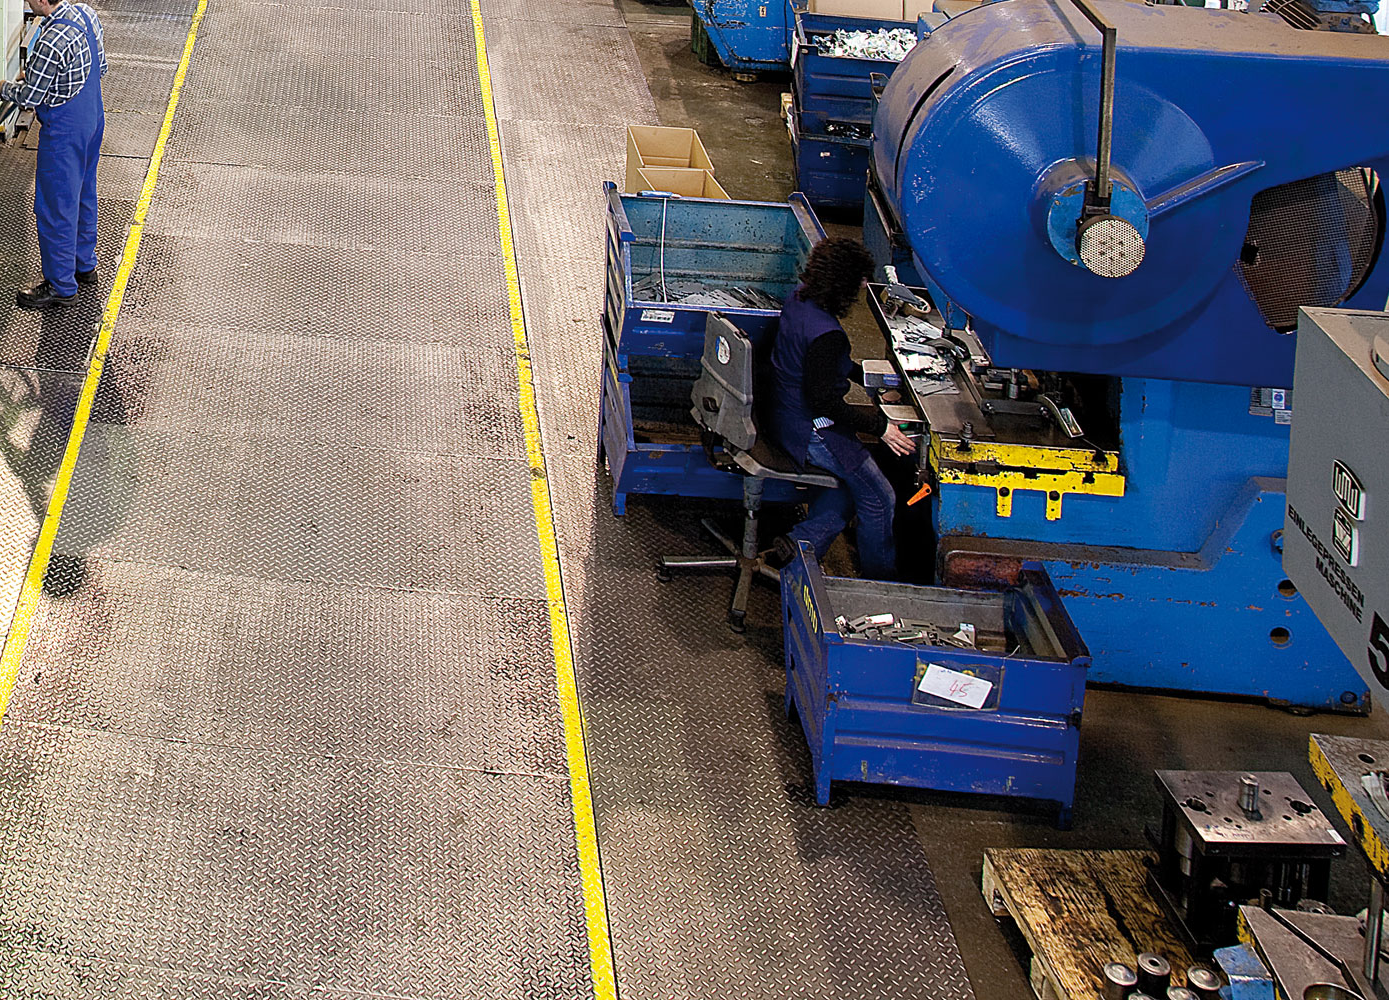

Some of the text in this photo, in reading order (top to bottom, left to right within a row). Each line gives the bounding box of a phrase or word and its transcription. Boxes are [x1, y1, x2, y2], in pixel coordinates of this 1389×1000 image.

[1287, 503, 1365, 608] EINLEGEPRESSEN
[1315, 555, 1363, 625] MASCHINE
[949, 679, 974, 698] 45
